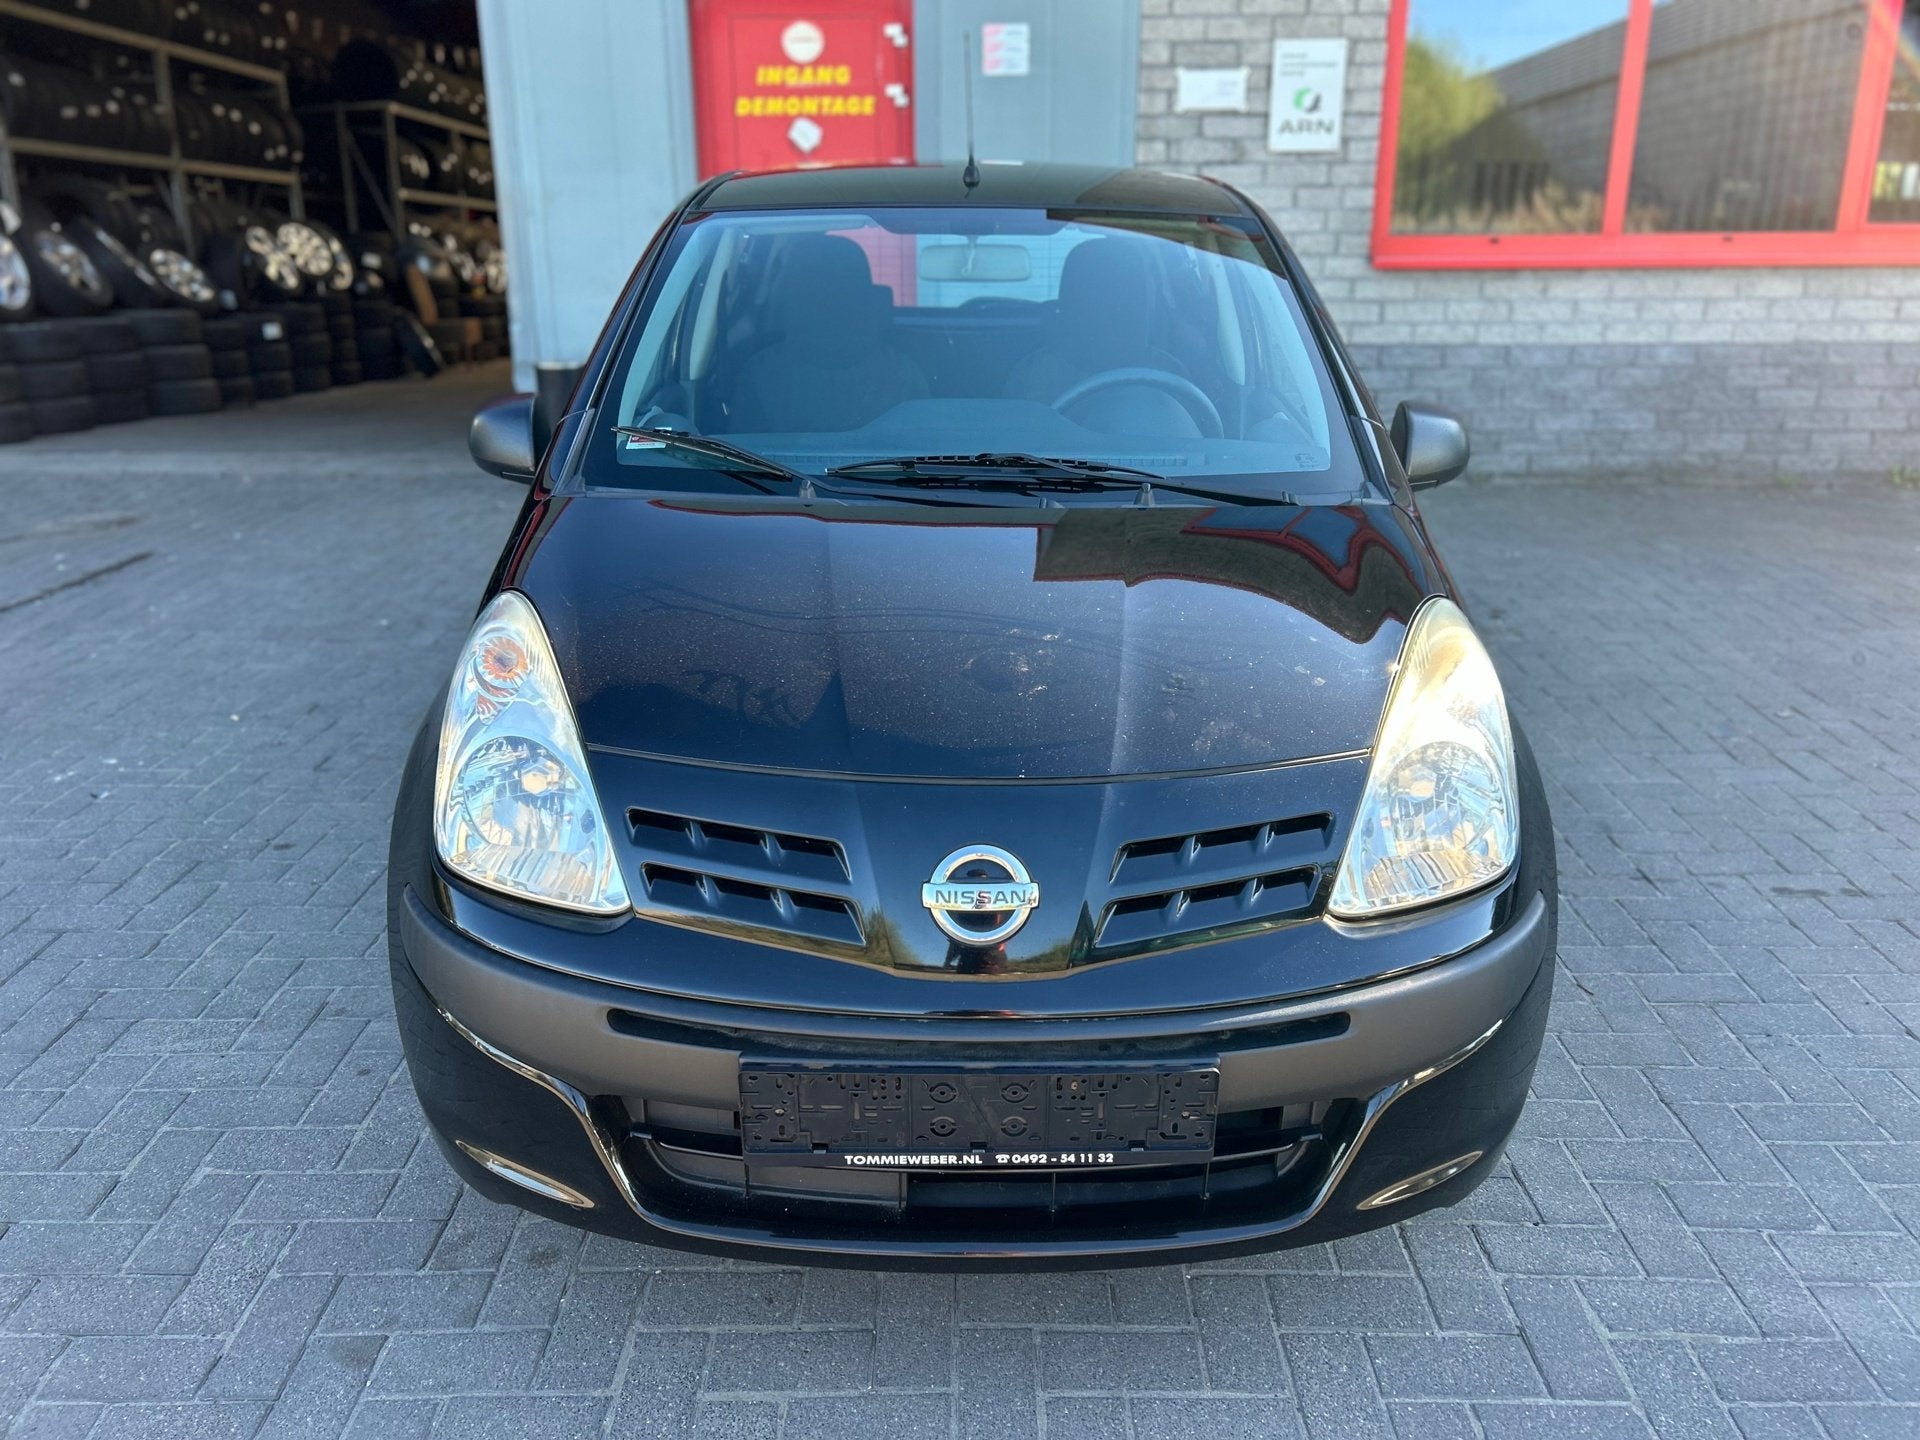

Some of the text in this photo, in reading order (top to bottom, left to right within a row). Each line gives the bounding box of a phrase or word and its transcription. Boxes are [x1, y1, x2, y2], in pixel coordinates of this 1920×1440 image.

[756, 66, 851, 85] INGANG
[735, 96, 876, 116] DEMONTAGE
[1279, 119, 1334, 134] ARN
[935, 889, 1026, 905] NISSAN
[844, 1154, 983, 1165] TOMMIEWEBER.NL
[1012, 1153, 1047, 1164] 0492
[1060, 1153, 1076, 1163] 54
[1080, 1153, 1093, 1163] 11
[1097, 1153, 1114, 1163] 32
